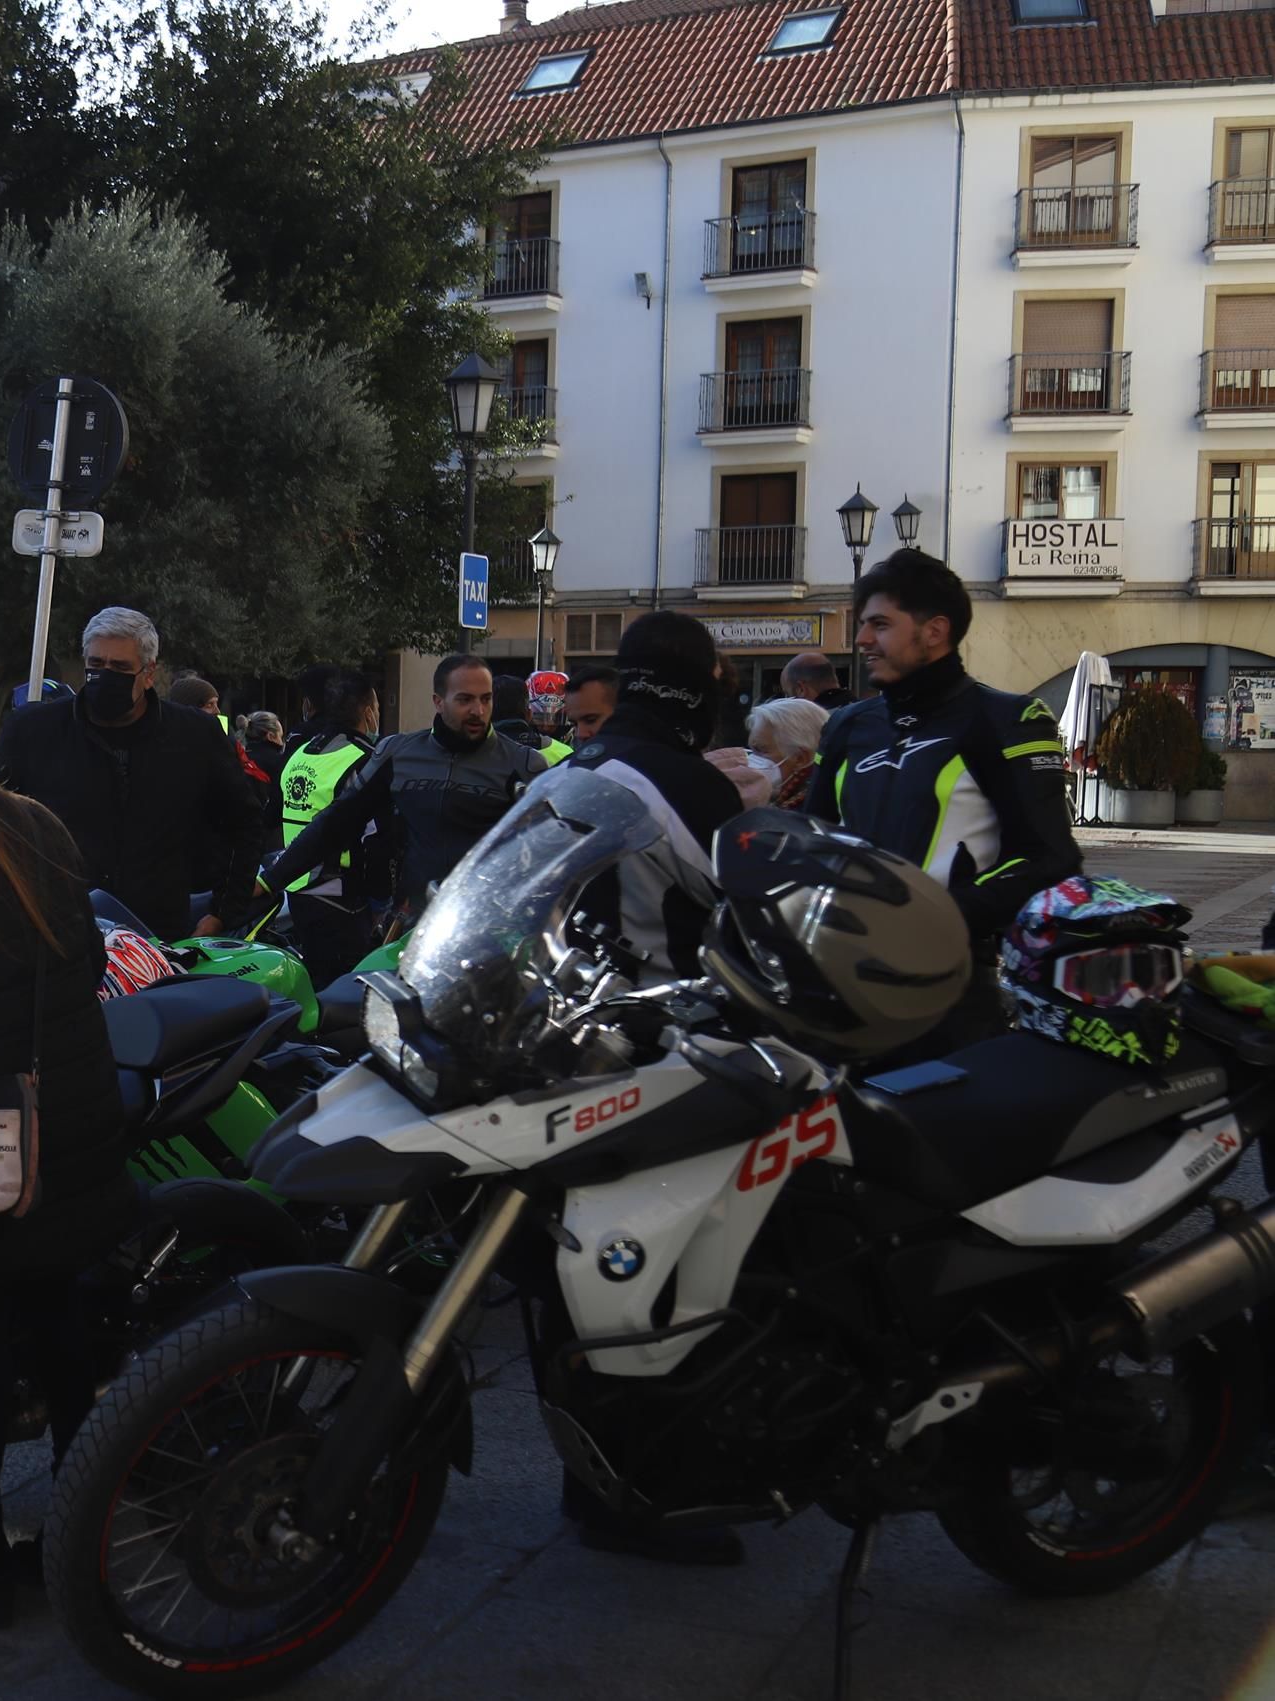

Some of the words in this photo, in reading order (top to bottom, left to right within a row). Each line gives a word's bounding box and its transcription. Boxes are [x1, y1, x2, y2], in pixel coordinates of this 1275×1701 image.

[1012, 523, 1118, 548] HOSTAL
[1018, 550, 1041, 566] La
[1050, 549, 1101, 566] Reina
[464, 580, 487, 604] TAXI
[736, 1092, 839, 1192] GS
